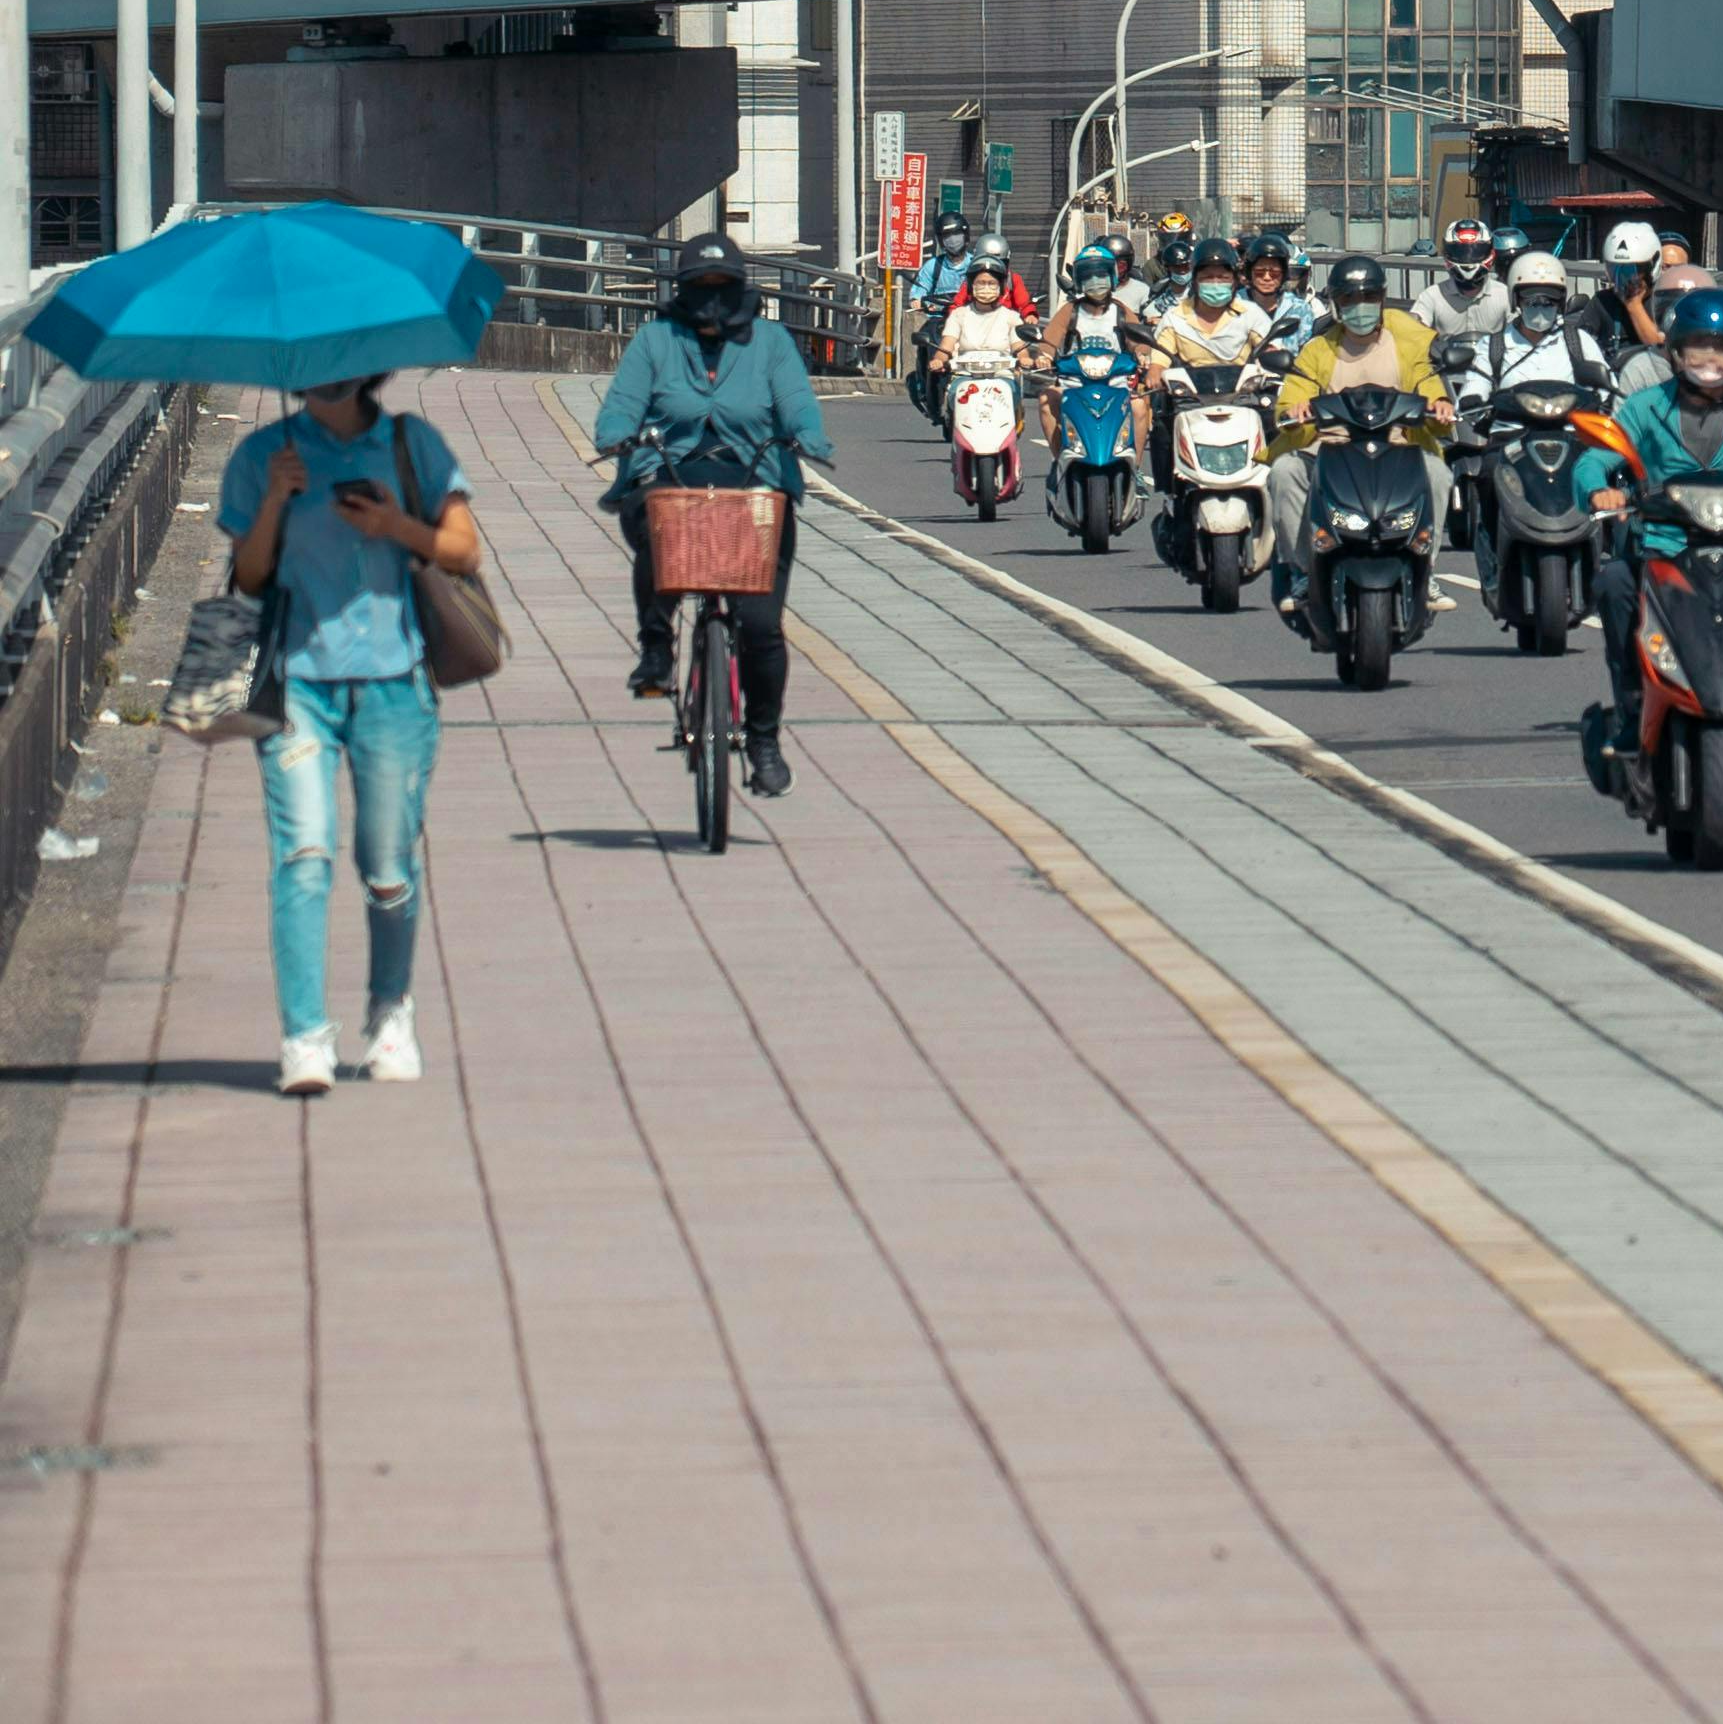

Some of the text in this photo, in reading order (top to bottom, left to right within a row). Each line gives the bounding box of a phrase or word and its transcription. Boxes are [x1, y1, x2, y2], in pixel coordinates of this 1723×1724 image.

[903, 158, 922, 245] 自行車牽引道
